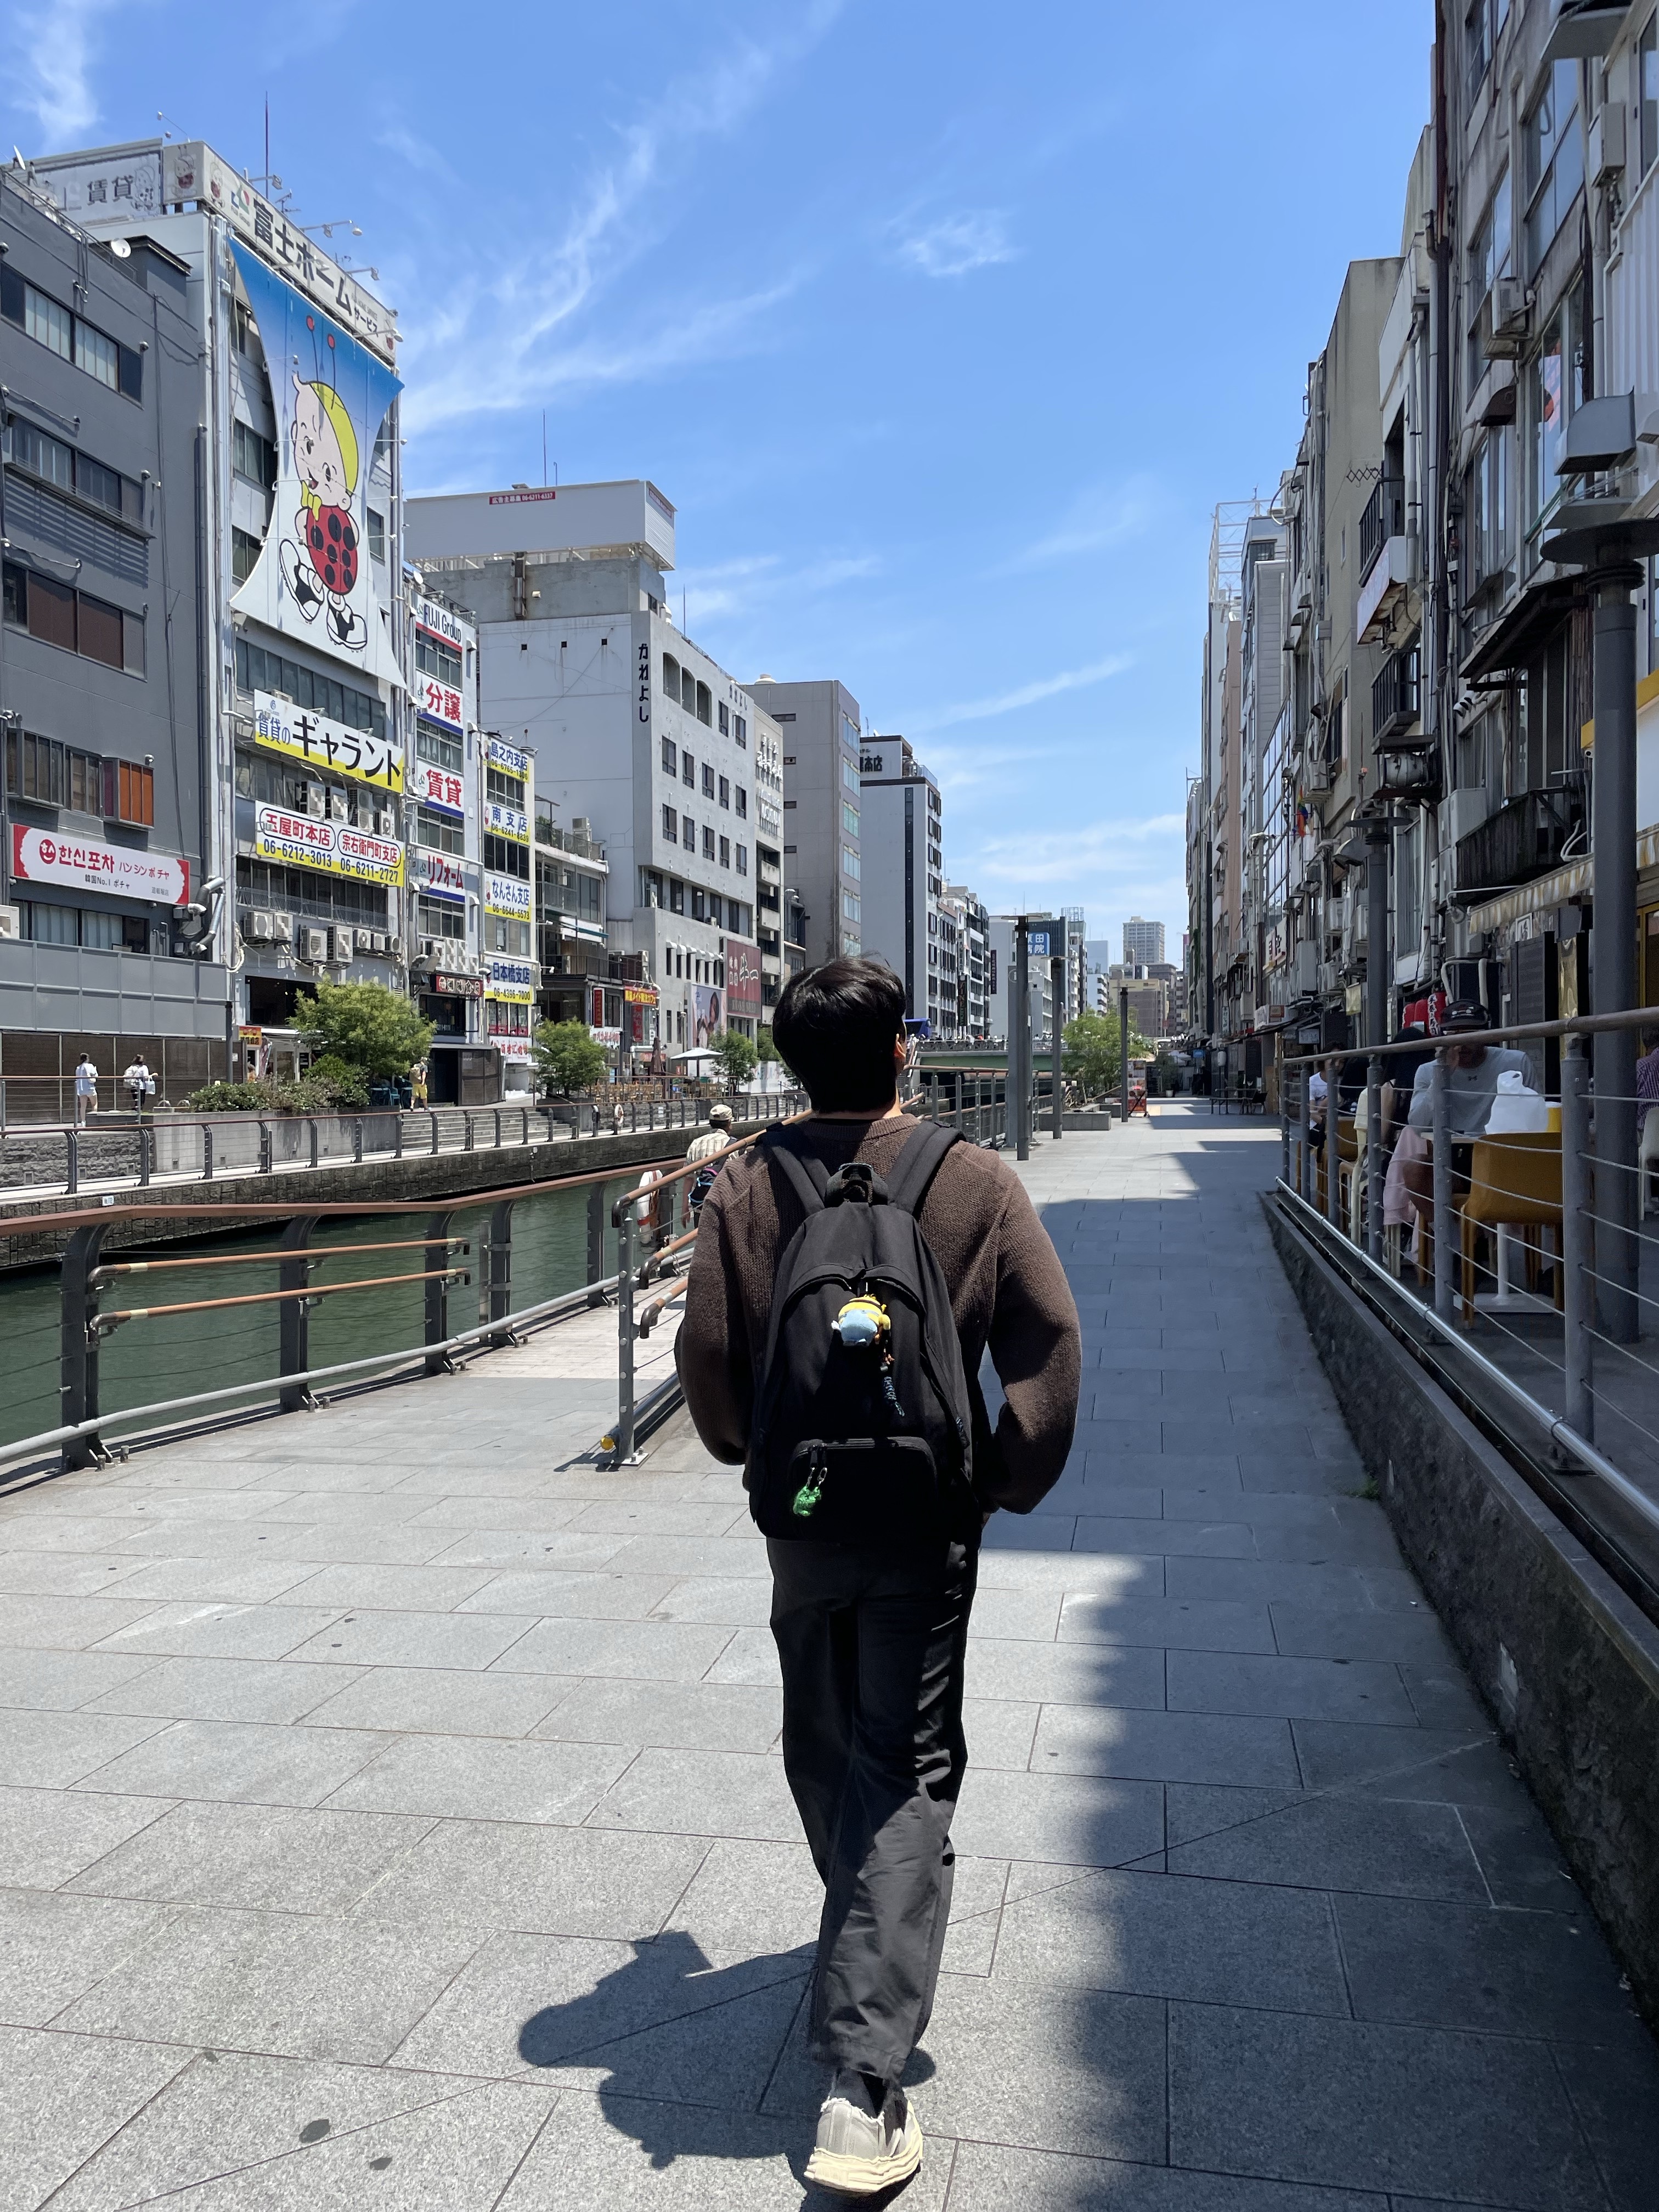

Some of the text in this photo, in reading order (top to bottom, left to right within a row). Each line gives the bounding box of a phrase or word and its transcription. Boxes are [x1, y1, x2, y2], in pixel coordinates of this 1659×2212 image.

[87, 175, 134, 206] 賃貸
[253, 198, 379, 337] 富士ホーム サービス
[424, 603, 461, 644] FUJI Group
[639, 643, 649, 723] かねよし
[426, 682, 461, 723] 分譲
[258, 713, 401, 787] 賃貸の ギャラント
[491, 741, 528, 771] 島之内支店
[426, 769, 461, 808] 賃貸
[266, 813, 331, 847] 玉屋町本店
[492, 806, 527, 832] 南支店
[59, 845, 115, 873] 한신포차
[264, 838, 332, 867] 06-6212-3013
[342, 834, 397, 864] 宗右衛門町支店
[340, 858, 398, 883] 06-6211-2727
[428, 855, 464, 890] リフォーム
[493, 879, 529, 906] なんさん支店
[493, 962, 530, 985] 日本橋支店
[494, 987, 531, 1001] 06-4396-7000
